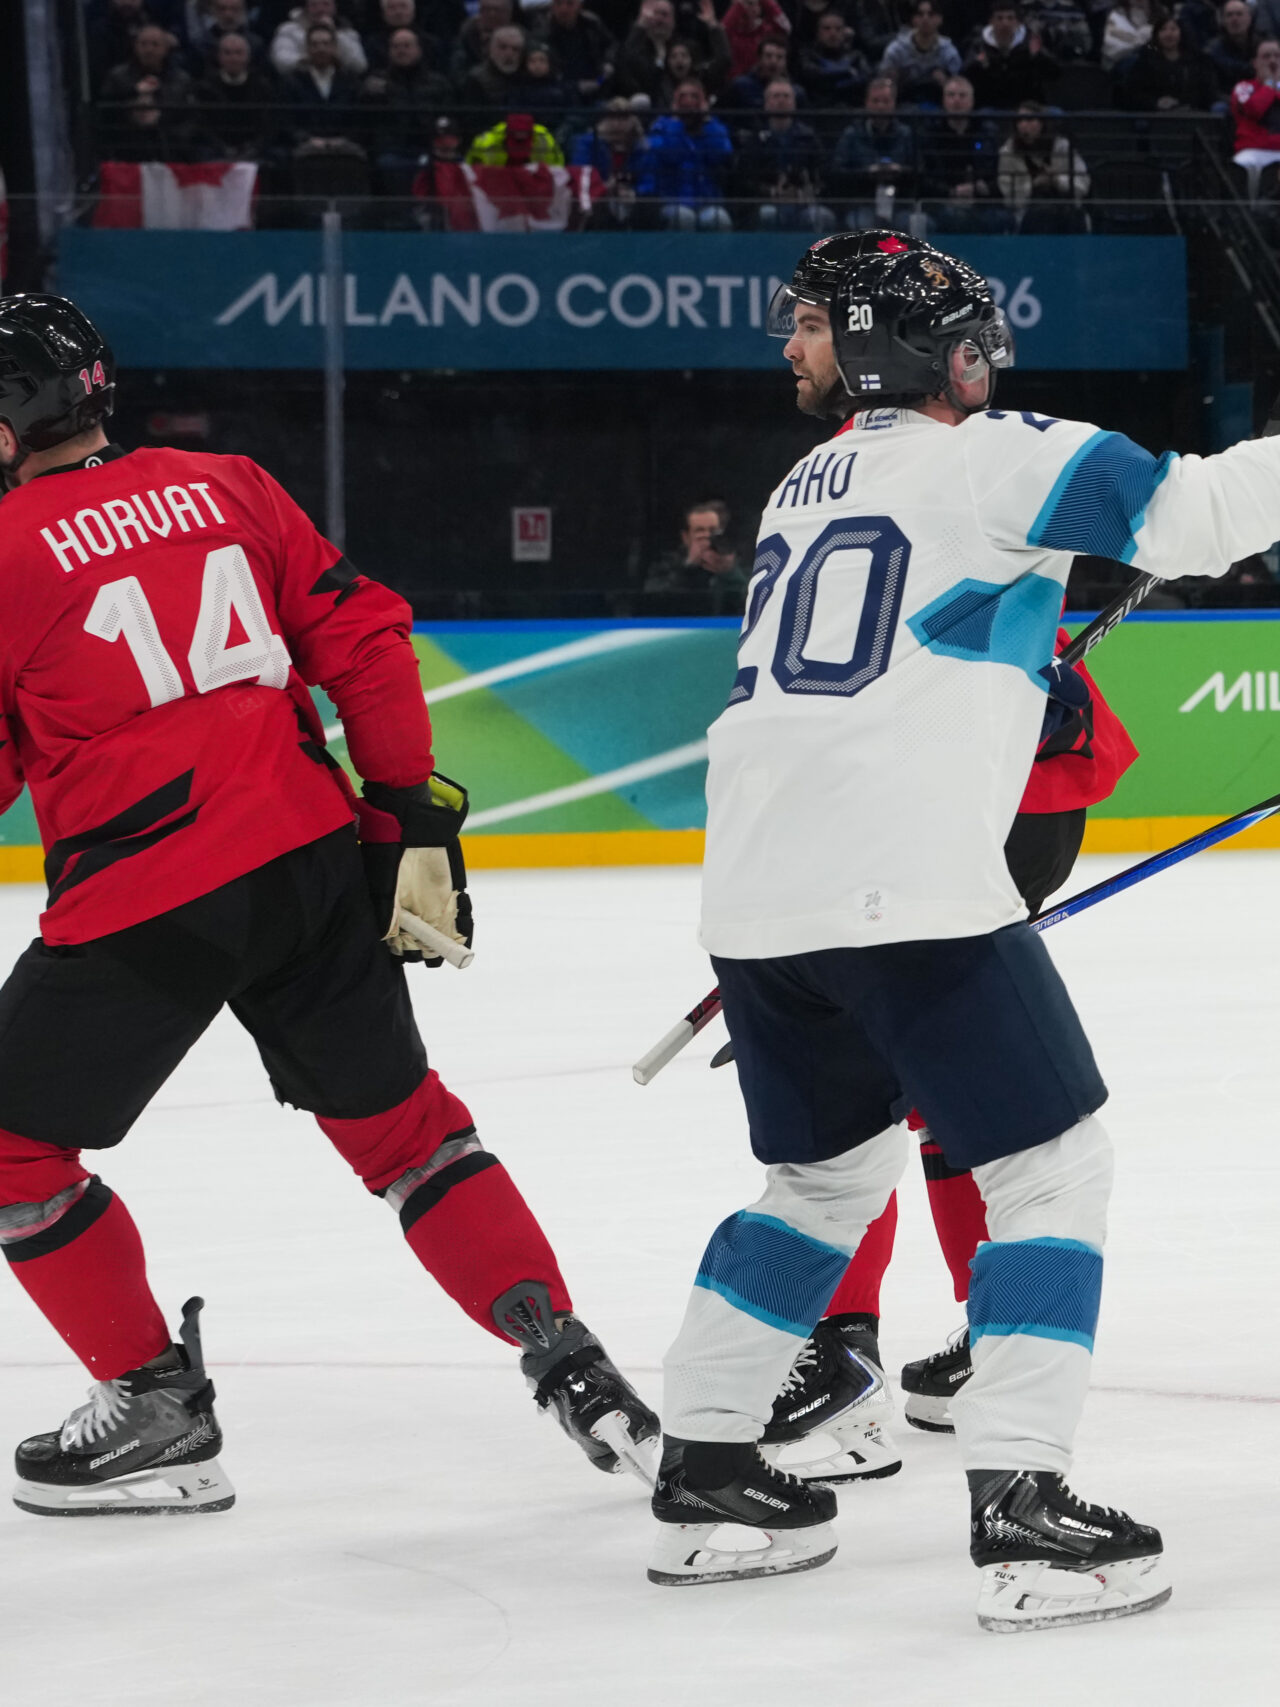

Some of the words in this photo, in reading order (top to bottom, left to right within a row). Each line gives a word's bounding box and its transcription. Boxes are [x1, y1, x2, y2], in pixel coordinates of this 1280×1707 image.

[214, 273, 540, 327] MILANO
[848, 304, 873, 332] 20
[79, 360, 106, 395] 14
[776, 451, 858, 508] AHO
[40, 482, 226, 573] HORVAT
[83, 543, 293, 708] 14
[725, 515, 912, 708] 20
[788, 1393, 831, 1422] BAUER
[89, 1439, 141, 1470] BAUER
[743, 1487, 791, 1512] BAUER
[1058, 1516, 1114, 1539] BAUER
